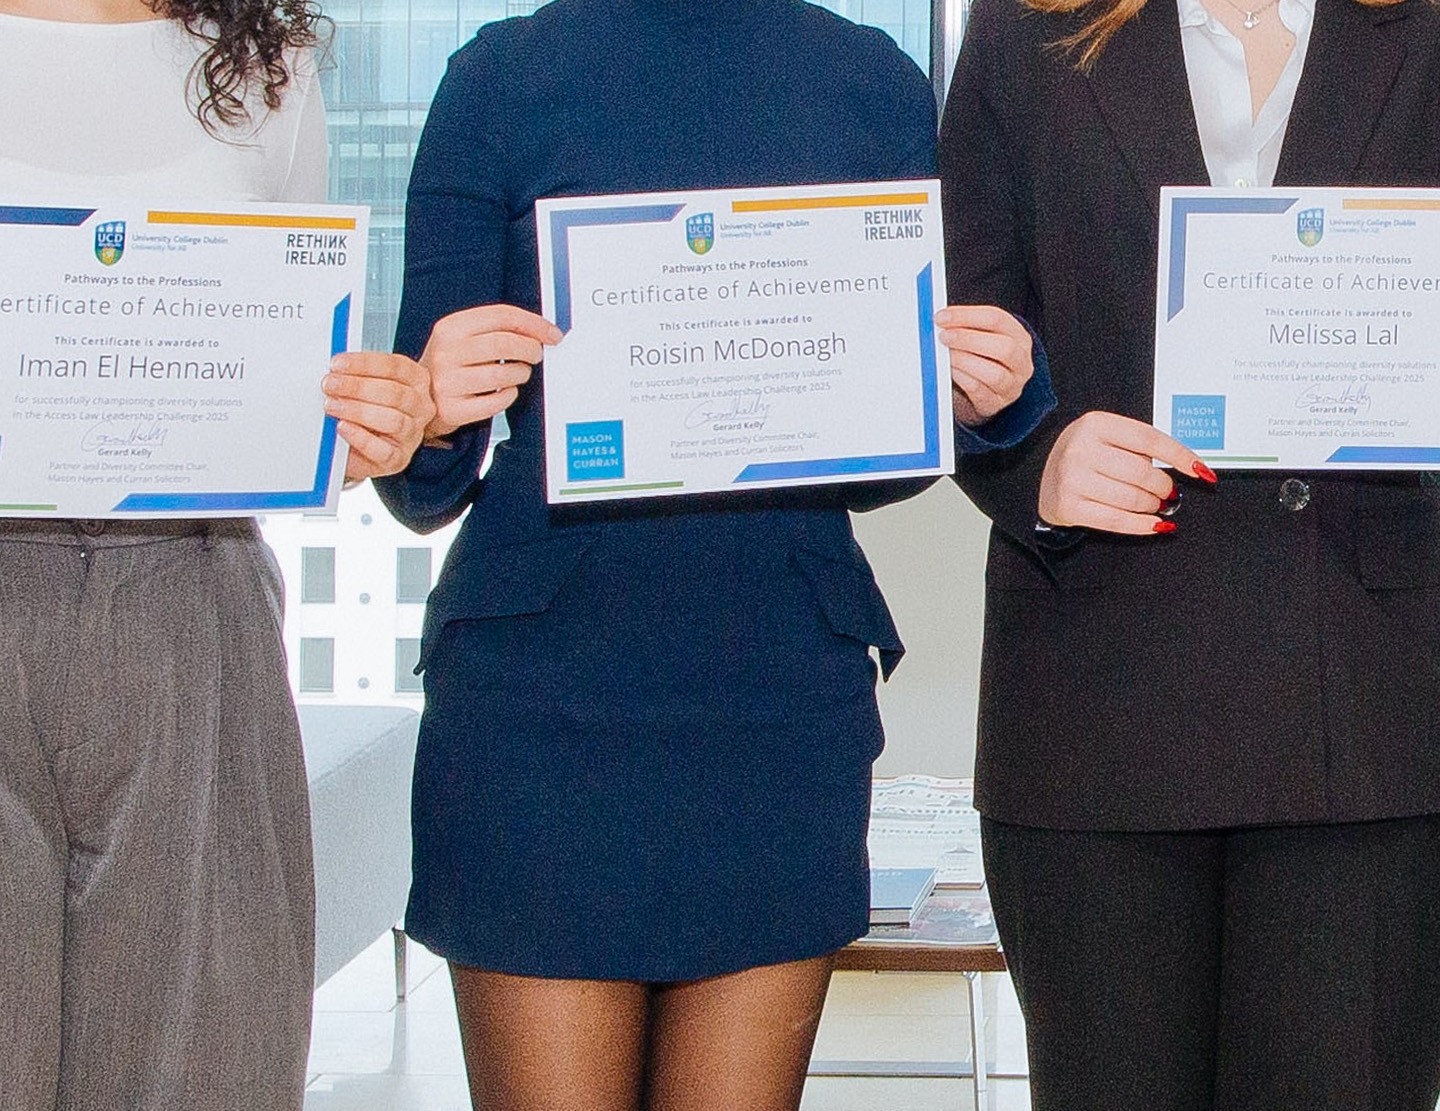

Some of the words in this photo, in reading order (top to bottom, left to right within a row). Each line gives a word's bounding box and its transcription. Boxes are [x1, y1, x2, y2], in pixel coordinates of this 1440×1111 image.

[1299, 219, 1322, 227] UCD
[688, 224, 712, 234] UCD
[865, 224, 923, 240] IRELAND
[97, 233, 123, 243] UCD
[285, 250, 346, 266] IRELAND
[1271, 254, 1319, 265] Pathways
[1322, 255, 1332, 263] to
[1335, 254, 1352, 263] the
[1354, 254, 1411, 264] Professions
[662, 263, 712, 274] Pathways
[715, 263, 726, 271] to
[728, 261, 746, 270] the
[749, 258, 808, 269] Professions
[64, 273, 119, 287] Pathways
[122, 276, 133, 284] to
[136, 275, 155, 285] the
[158, 275, 221, 287] Professions
[1203, 271, 1313, 290] Certificate
[1322, 272, 1344, 290] of
[591, 284, 708, 306] Certificate
[717, 280, 739, 299] of
[747, 275, 888, 297] Achievement
[121, 296, 145, 315] of
[152, 297, 303, 319] Achievement
[1265, 308, 1285, 316] This
[1288, 308, 1341, 316] Certificate
[1355, 309, 1398, 317] awarded
[659, 322, 680, 330] This
[684, 319, 739, 329] Certificate
[743, 318, 751, 326] is
[754, 315, 798, 325] awarded
[802, 315, 812, 323] to
[1269, 323, 1356, 345] Melissa
[1366, 324, 1397, 345] Lal
[54, 336, 77, 345] This
[80, 336, 141, 346] Certificate
[144, 338, 153, 346] is
[157, 338, 204, 347] awarded
[208, 339, 219, 347] to
[630, 341, 704, 366] Roisin
[714, 331, 846, 361] McDonagh
[19, 354, 87, 377] Iman
[97, 354, 119, 378] El
[129, 355, 244, 379] Hennawi
[1338, 406, 1358, 415] Kelly
[714, 423, 743, 431] Gerard
[744, 421, 764, 430] Kelly
[572, 434, 612, 444] MASON
[1178, 429, 1219, 438] CURRAN
[98, 449, 129, 457] Gerard
[131, 449, 153, 459] Kelly
[573, 458, 619, 469] CURRAN
